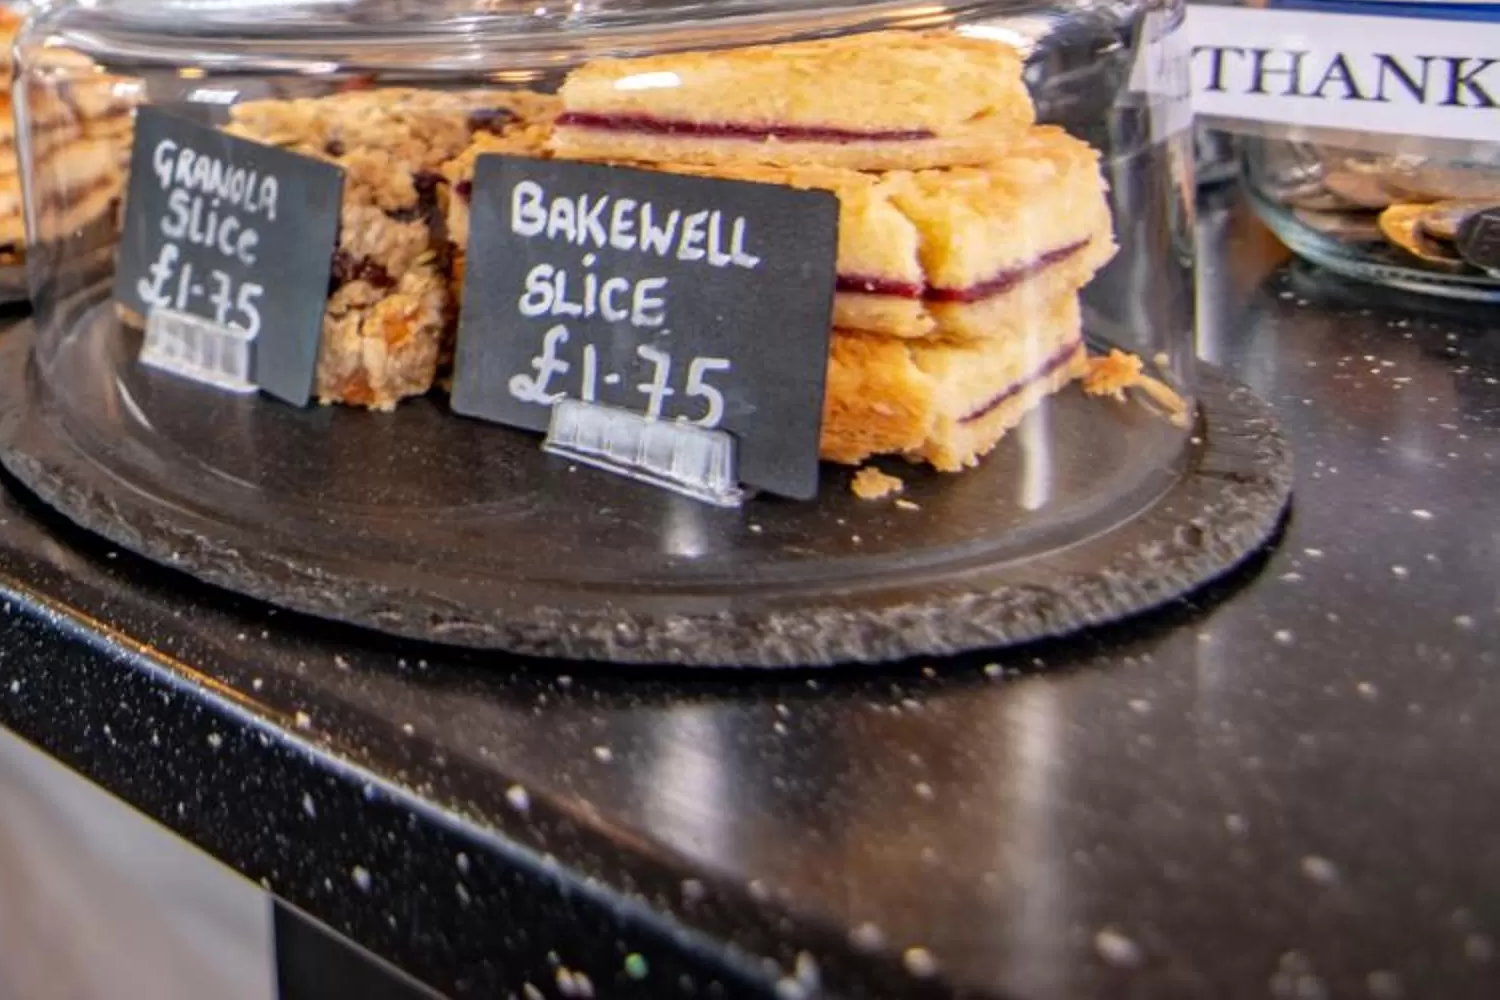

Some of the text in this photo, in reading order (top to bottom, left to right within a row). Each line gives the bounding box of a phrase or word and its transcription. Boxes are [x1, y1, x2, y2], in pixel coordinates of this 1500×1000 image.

[1191, 43, 1500, 110] THANK
[153, 138, 279, 222] GRANOLA
[510, 179, 761, 269] BAKEWELL
